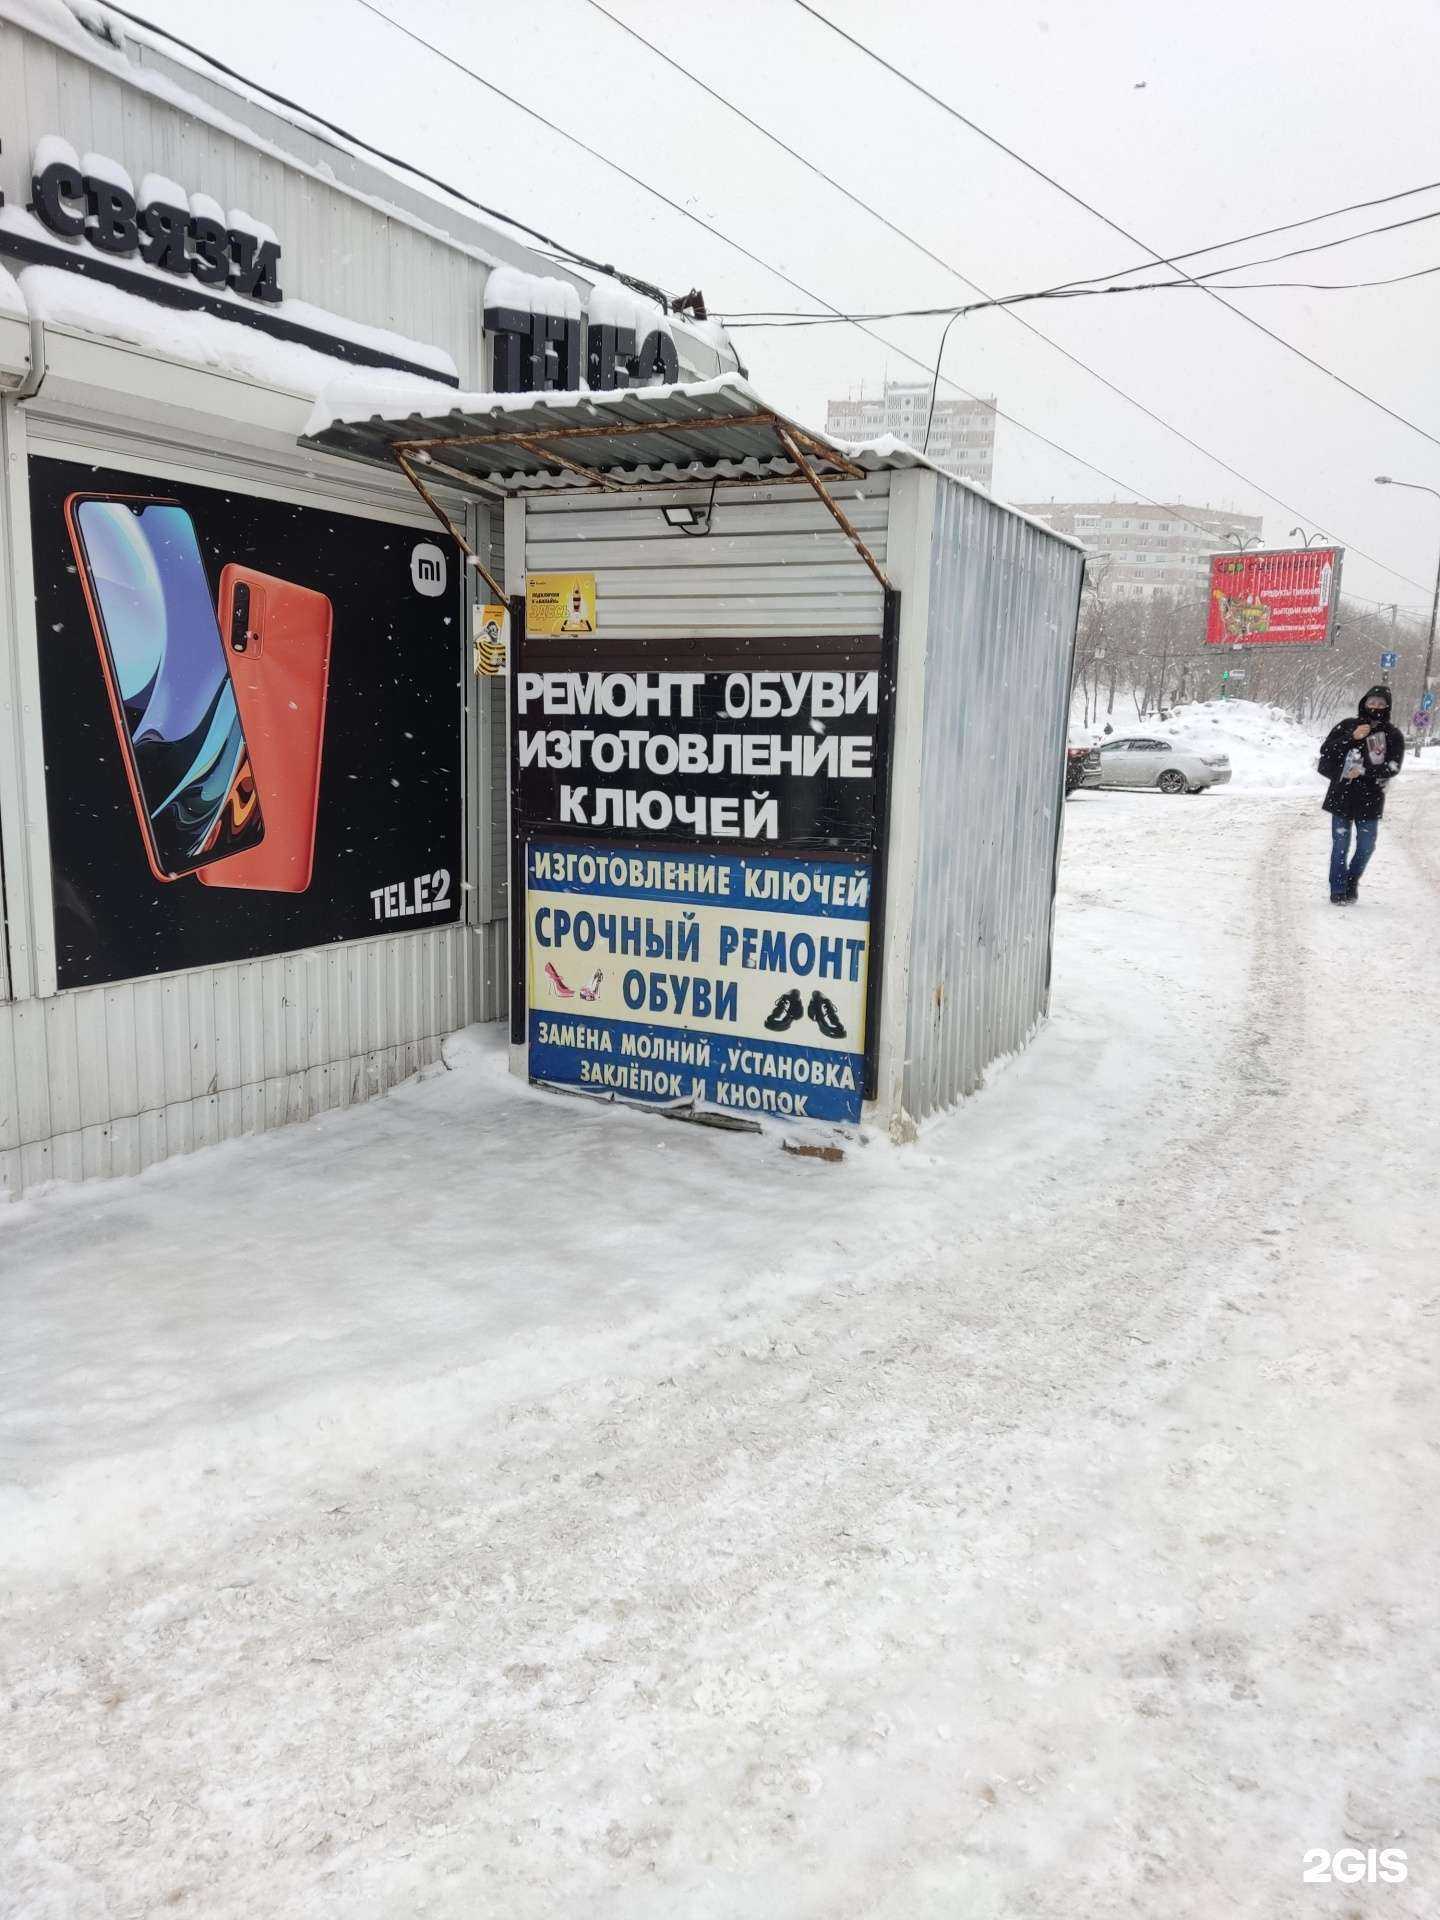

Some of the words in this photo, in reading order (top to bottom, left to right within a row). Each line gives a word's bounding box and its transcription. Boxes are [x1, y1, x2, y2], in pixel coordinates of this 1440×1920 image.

[31, 162, 283, 302] СВЯЗИ
[517, 671, 705, 717] РЕМОНТ
[725, 671, 879, 718] ОБУВИ
[518, 730, 873, 778] ИЗГОТОВЛЕНИЕ
[560, 785, 778, 839] КЛЮЧЕЙ
[370, 869, 451, 920] TELE2
[534, 851, 731, 896] ИЗГОТОВЛЕНИЕ
[744, 869, 869, 908] КЛЮЧЕЙ
[534, 907, 700, 963] СРОЧНЫЙ
[719, 925, 866, 982] РЕМОНТ
[622, 968, 739, 1022] ОБУВИ
[538, 1022, 613, 1053] ЗАМЕНА
[621, 1033, 711, 1067] МОЛНИЙ
[580, 1060, 682, 1097] ЗАКЛЁПОК
[691, 1077, 707, 1099] И
[716, 1082, 809, 1117] КНОПОК
